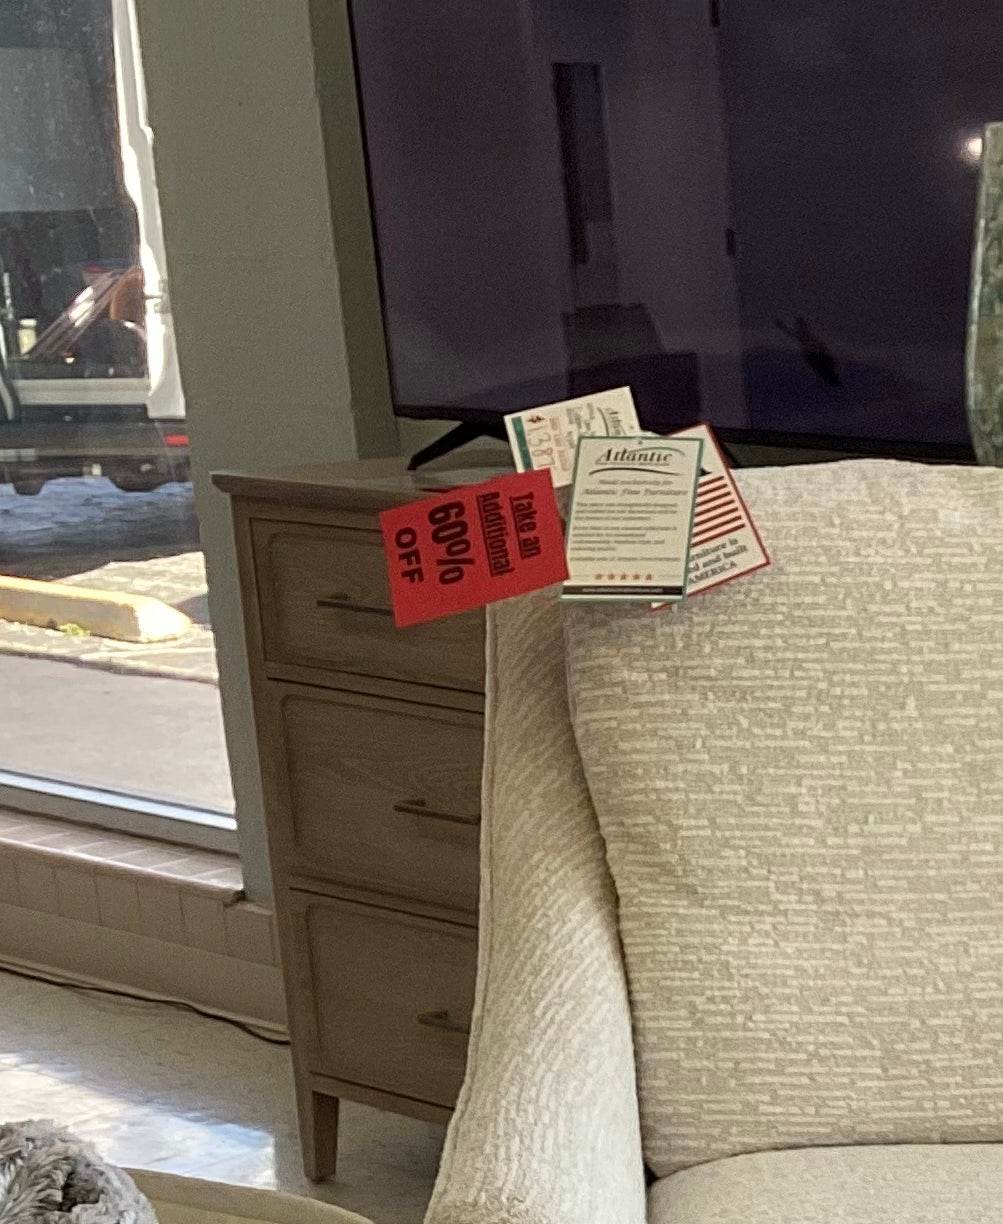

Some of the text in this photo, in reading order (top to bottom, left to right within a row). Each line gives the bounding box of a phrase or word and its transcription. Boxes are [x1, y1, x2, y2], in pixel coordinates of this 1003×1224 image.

[595, 448, 673, 465] Atlantic
[395, 526, 425, 584] OFF
[428, 500, 475, 585] 60%
[477, 491, 516, 578] Additional
[510, 491, 543, 560] Take an
[702, 553, 722, 568] and
[722, 544, 750, 559] built
